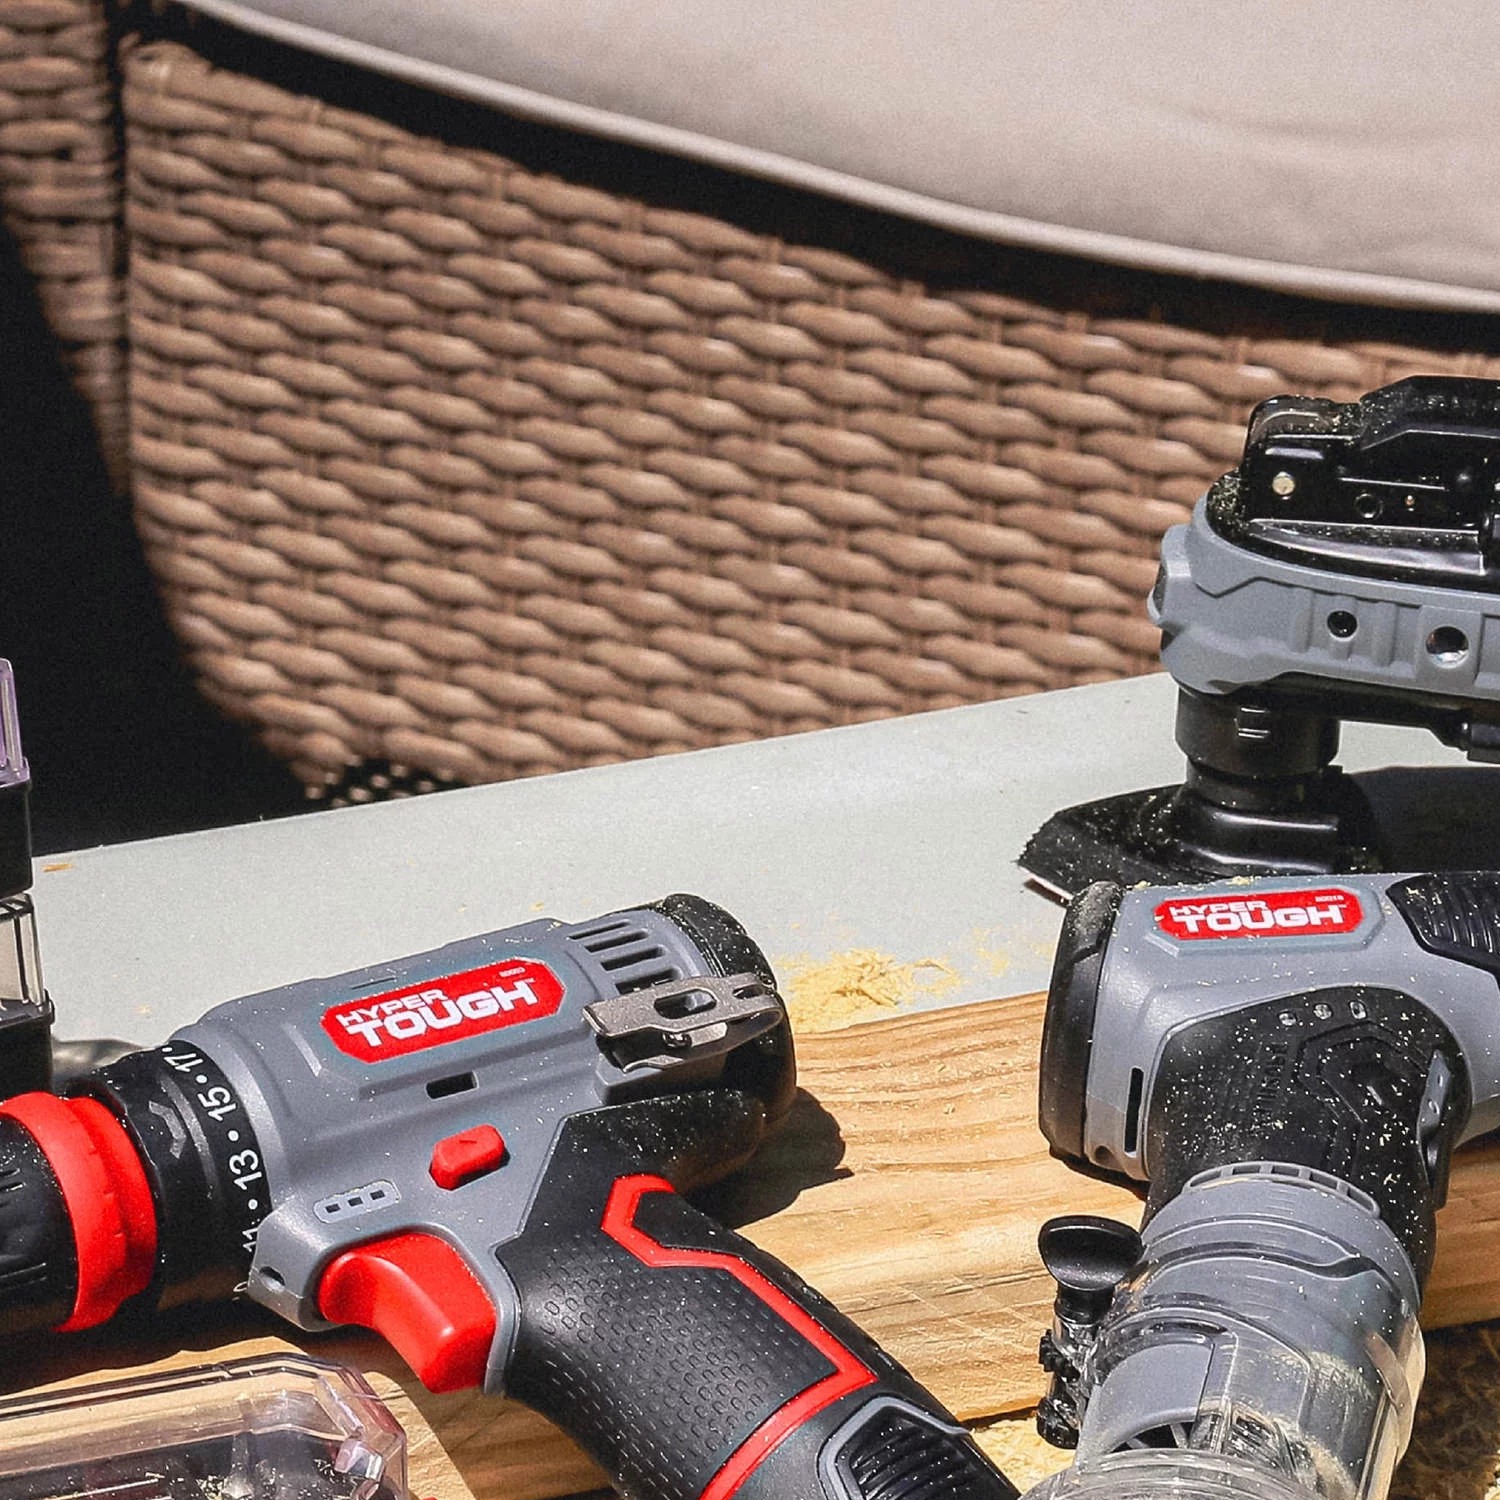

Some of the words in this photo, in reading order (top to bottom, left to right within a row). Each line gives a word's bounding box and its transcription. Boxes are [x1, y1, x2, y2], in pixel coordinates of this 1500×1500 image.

[1169, 900, 1268, 917] HYPER
[1172, 905, 1344, 933] TOUGH
[335, 988, 449, 1027] HYPER
[345, 980, 538, 1048] TOUGH
[163, 1052, 204, 1072] 17
[197, 1087, 236, 1121] 15
[229, 1149, 262, 1190] 13
